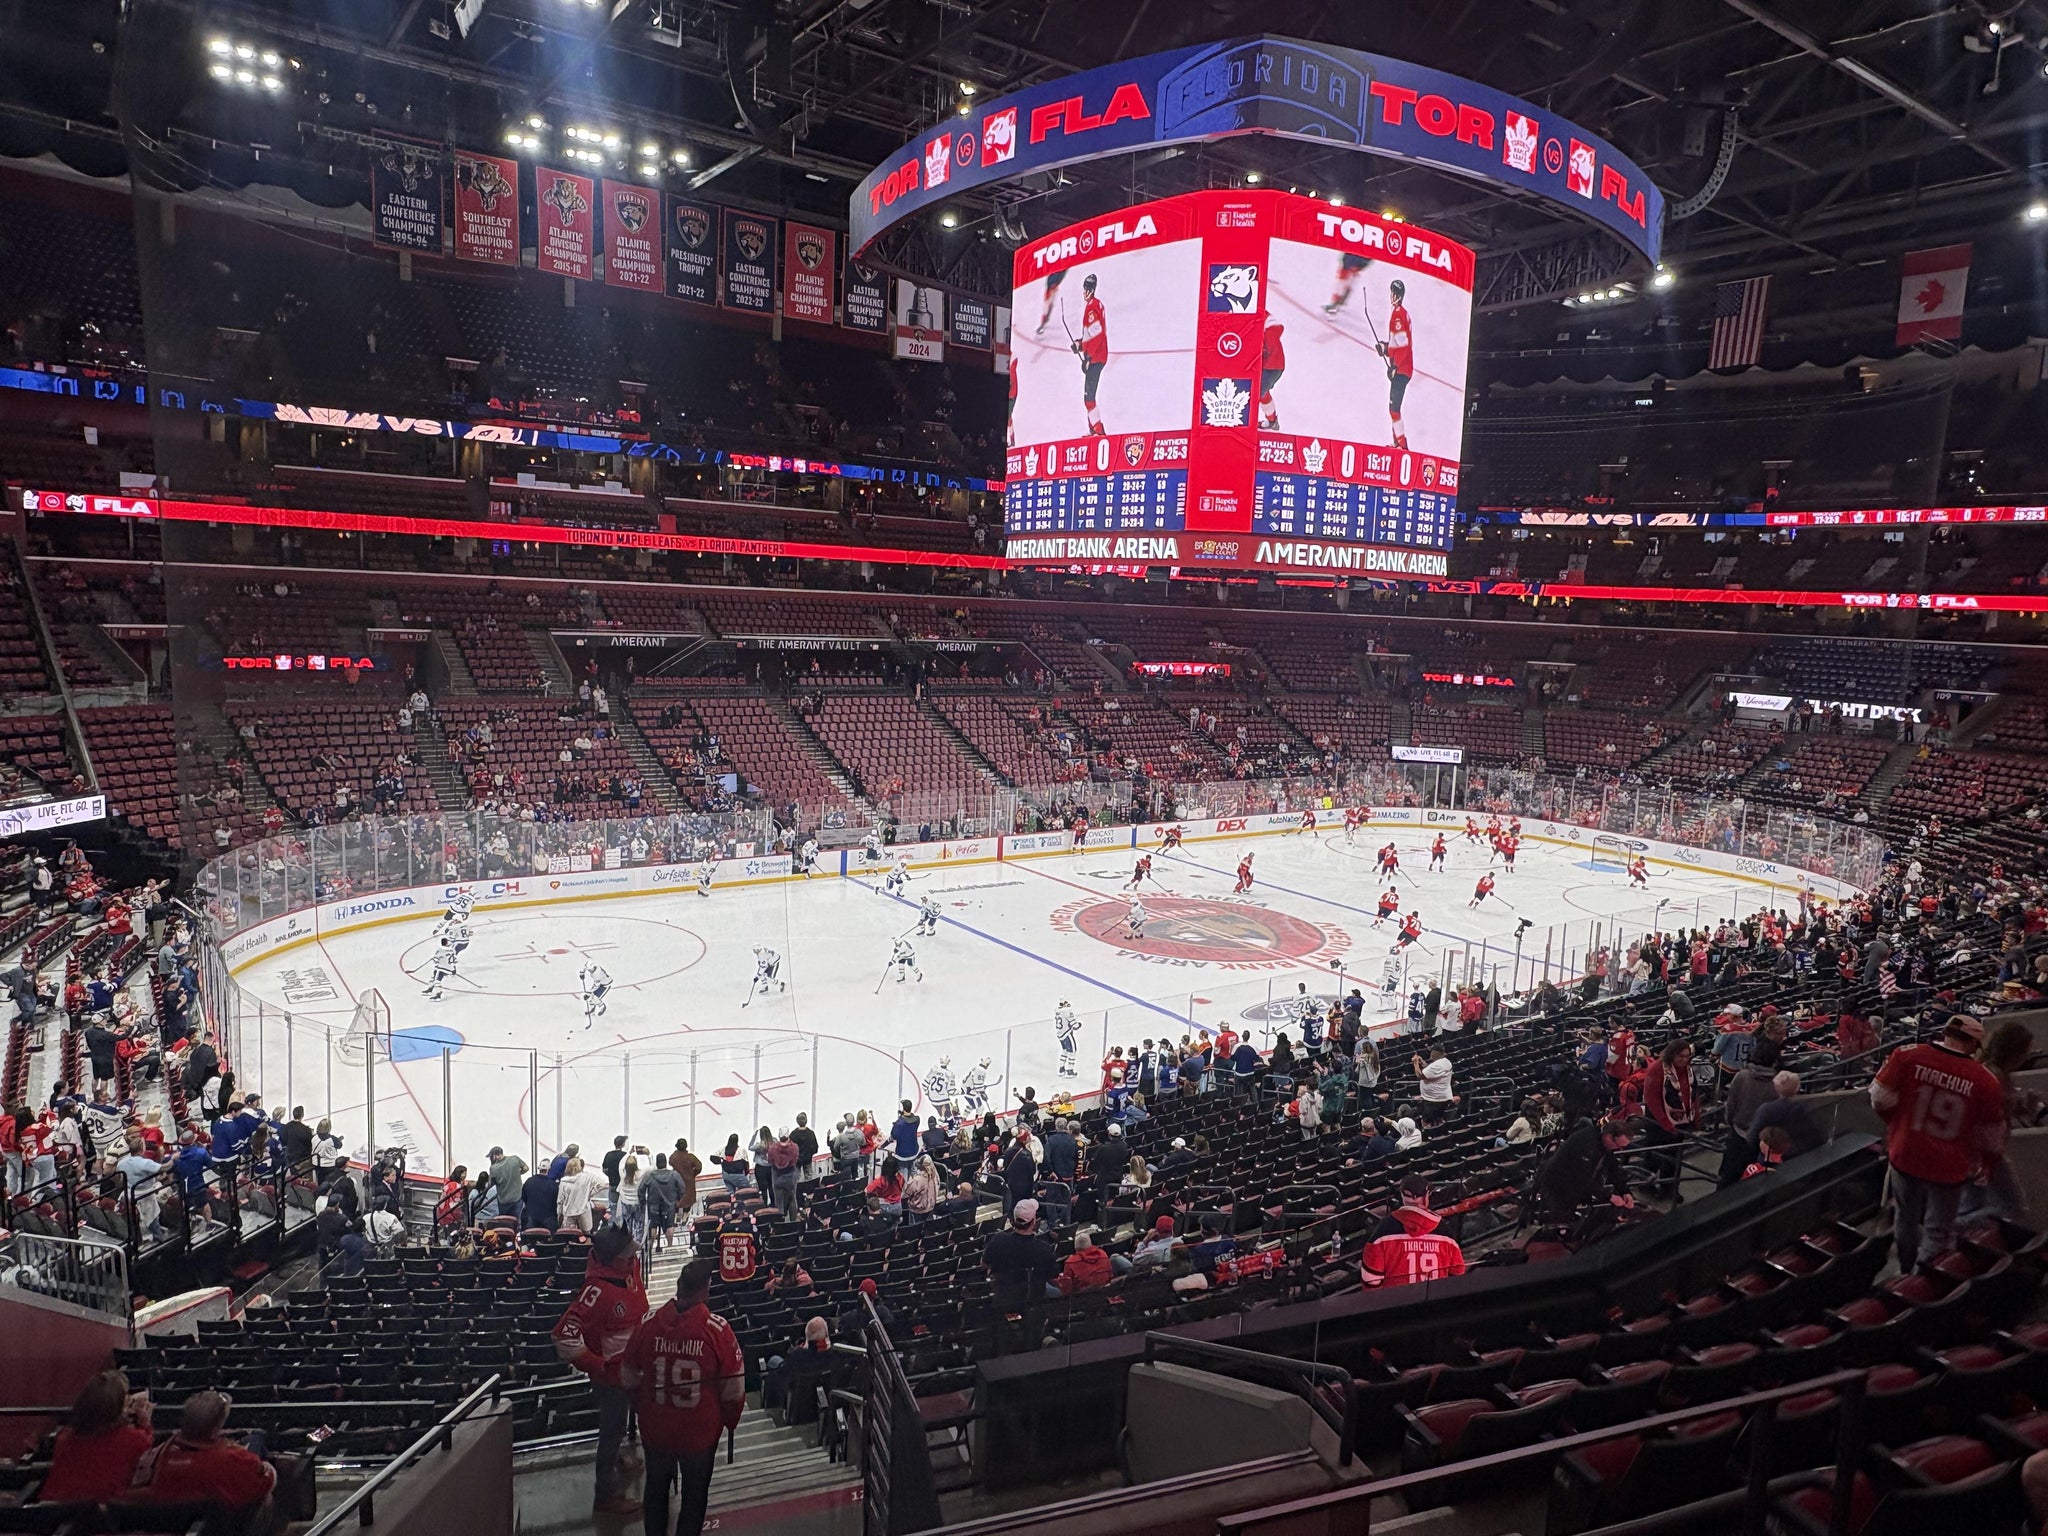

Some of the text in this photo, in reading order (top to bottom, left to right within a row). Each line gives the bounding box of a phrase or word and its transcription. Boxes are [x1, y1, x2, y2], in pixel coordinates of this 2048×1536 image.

[869, 83, 1151, 217] TOR VS FLA
[1369, 80, 1646, 228] TOR VS FLA
[389, 193, 428, 210] EASTERN
[381, 204, 436, 224] CONFERENCE
[463, 212, 513, 228] SOUTHEAST
[382, 217, 435, 236] CHAMPIONS
[469, 223, 507, 238] DIVISION
[549, 226, 584, 242] ATLANTIC
[391, 231, 428, 247] 1995-96
[463, 233, 513, 250] CHAMPIONS
[550, 237, 582, 252] DIVISION
[616, 236, 651, 251] ATLANTIC
[1033, 214, 1158, 269] TOR VS FLA
[1316, 212, 1452, 273] TOR VS FLA
[544, 245, 587, 264] CHAMPIONS
[617, 248, 650, 262] DIVISION
[671, 248, 713, 266] PRESIDENTS'
[612, 258, 656, 274] CHAMPIONS
[679, 261, 705, 276] TROPHY
[736, 262, 765, 276] EASTERN
[619, 271, 650, 284] 2021-22
[729, 272, 770, 288] CONFERENCE
[795, 273, 824, 286] ATLANTIC
[677, 283, 705, 298] 2021-22
[730, 283, 770, 298] CHAMPIONS
[795, 283, 823, 296] DIVISION
[853, 284, 879, 297] EASTERN
[736, 294, 764, 307] 2022-23
[790, 293, 827, 307] CHAMPIONS
[847, 293, 884, 308] CONFERENCE
[795, 304, 822, 316] 2023-24
[848, 303, 883, 317] CHAMPIONS
[960, 303, 984, 316] EASTERN
[853, 314, 877, 327] 2023-24
[955, 312, 988, 327] CONFERENCE
[955, 322, 987, 336] CHAMPIONS
[909, 343, 930, 357] 2024
[1222, 340, 1238, 350] VS
[384, 415, 442, 435] VS
[1047, 444, 1057, 475] 0
[1065, 446, 1088, 464] 15:17
[1097, 438, 1109, 471] 0
[1259, 448, 1294, 464] 27-22-9
[1341, 444, 1355, 478] 0
[1366, 452, 1391, 472] 15:17
[729, 453, 841, 475] TOR FLA
[1400, 453, 1411, 485] 0
[93, 497, 152, 515] FLA
[1176, 482, 1186, 516] CENTRAL
[1254, 485, 1265, 519] CENTRAL
[1592, 513, 1634, 526] VS
[566, 530, 613, 545] TORONTO
[616, 533, 650, 547] MAPLE
[652, 536, 682, 549] LEAFS
[699, 539, 736, 552] FLORIDA
[740, 542, 785, 555] PANTHERS
[1006, 537, 1179, 560] AMERANT BANK ARENA
[1254, 541, 1448, 577] AMERANT BANK ARENA
[1435, 582, 1472, 592] VS
[1841, 594, 1978, 607] TOR FLA
[610, 636, 667, 647] AMERANT
[758, 639, 861, 651] THE AMERANT VAULT
[936, 643, 977, 652] AMERANT
[223, 657, 375, 669] TOR FLA
[1422, 673, 1515, 686] TOR FLA
[1936, 692, 1951, 700] 109
[1376, 811, 1410, 819] AMAZING
[1216, 818, 1248, 833] DEX
[653, 869, 691, 882] Surfside
[1763, 863, 1779, 874] XL
[492, 881, 520, 894] CH
[350, 897, 416, 917] HONDA
[246, 932, 268, 951] Health
[1311, 1027, 1322, 1040] 34
[931, 1076, 945, 1093] 25
[1914, 1064, 1975, 1097] TKACHUK
[1911, 1084, 1966, 1141] 19
[1403, 1240, 1441, 1253] TKACHUK
[722, 1246, 749, 1270] 63
[1406, 1252, 1439, 1284] 19
[579, 1283, 602, 1308] 13
[706, 1313, 728, 1332] 19
[654, 1336, 705, 1357] TKACHUK
[653, 1356, 701, 1409] 19
[702, 1519, 720, 1532] 22
